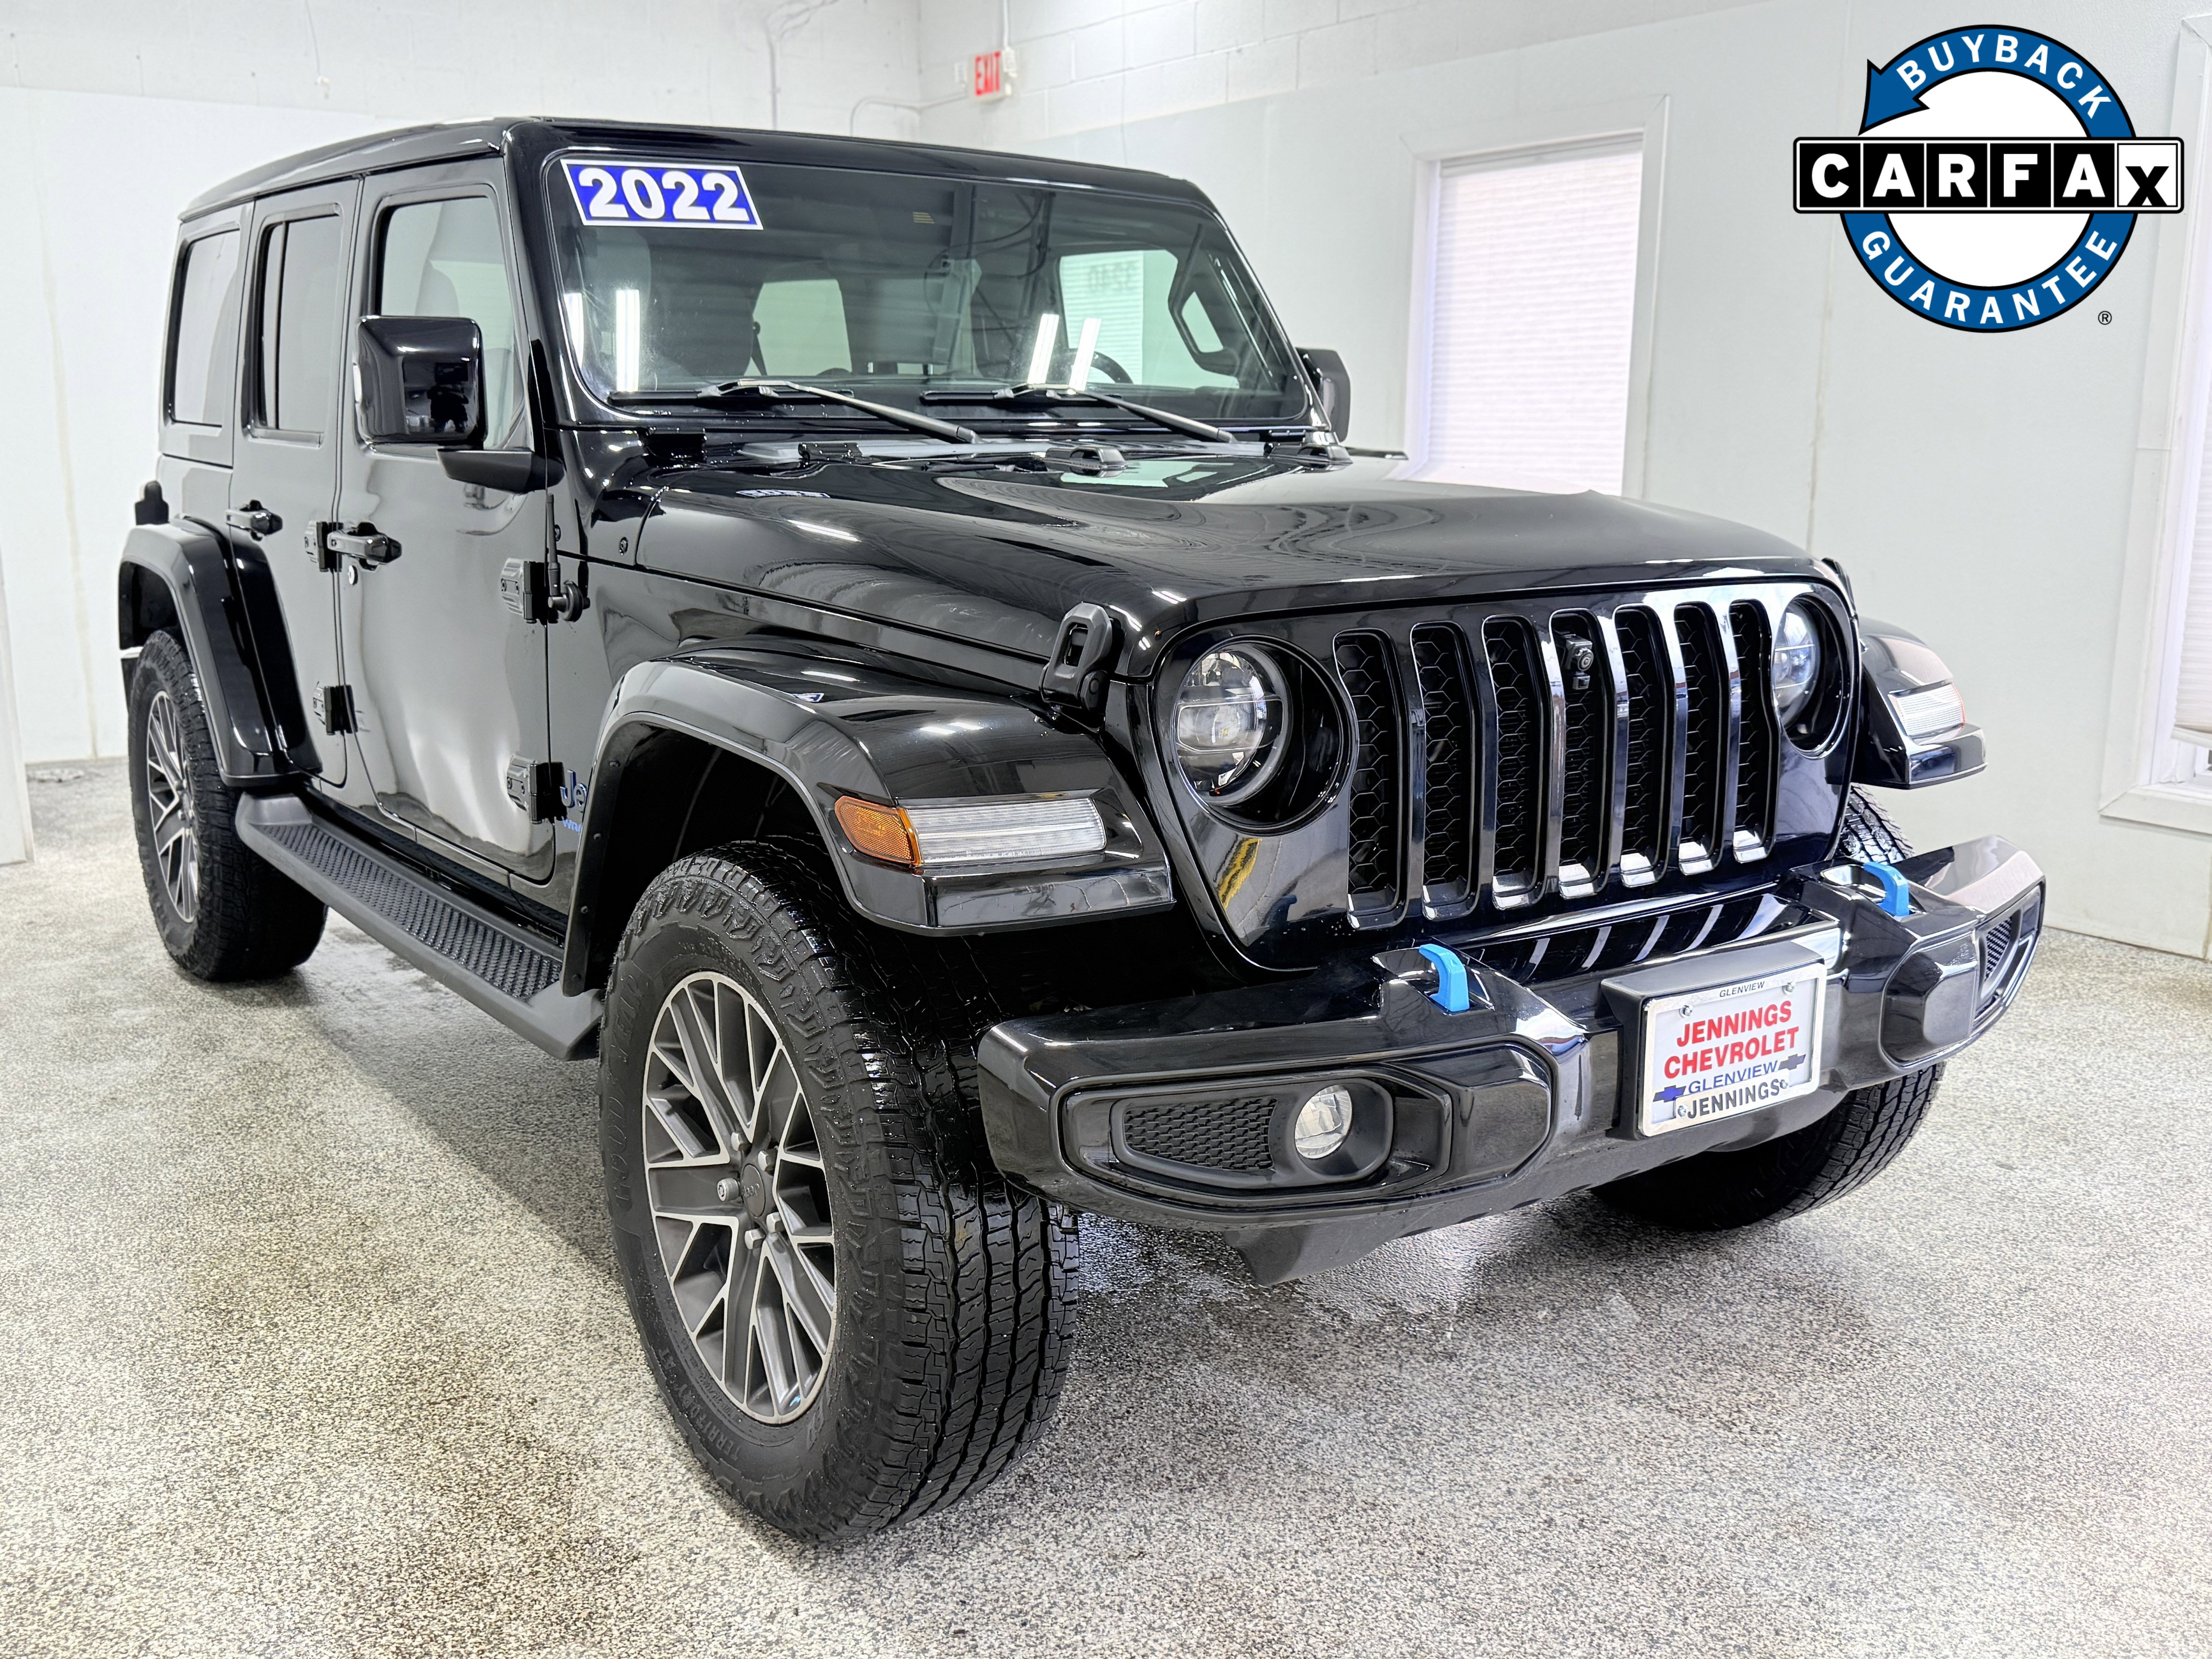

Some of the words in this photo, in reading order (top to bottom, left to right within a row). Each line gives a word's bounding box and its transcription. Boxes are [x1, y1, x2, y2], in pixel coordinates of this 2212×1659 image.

[975, 51, 1001, 97] EXIT
[579, 167, 750, 221] 2022
[1719, 981, 1765, 998] GLENVIEW
[1677, 1000, 1792, 1047] JENNINGS
[1664, 1027, 1799, 1079] CHEVROLET
[1687, 1078, 1781, 1119] JENNINGS
[1688, 1060, 1778, 1094] GLENVIEW
